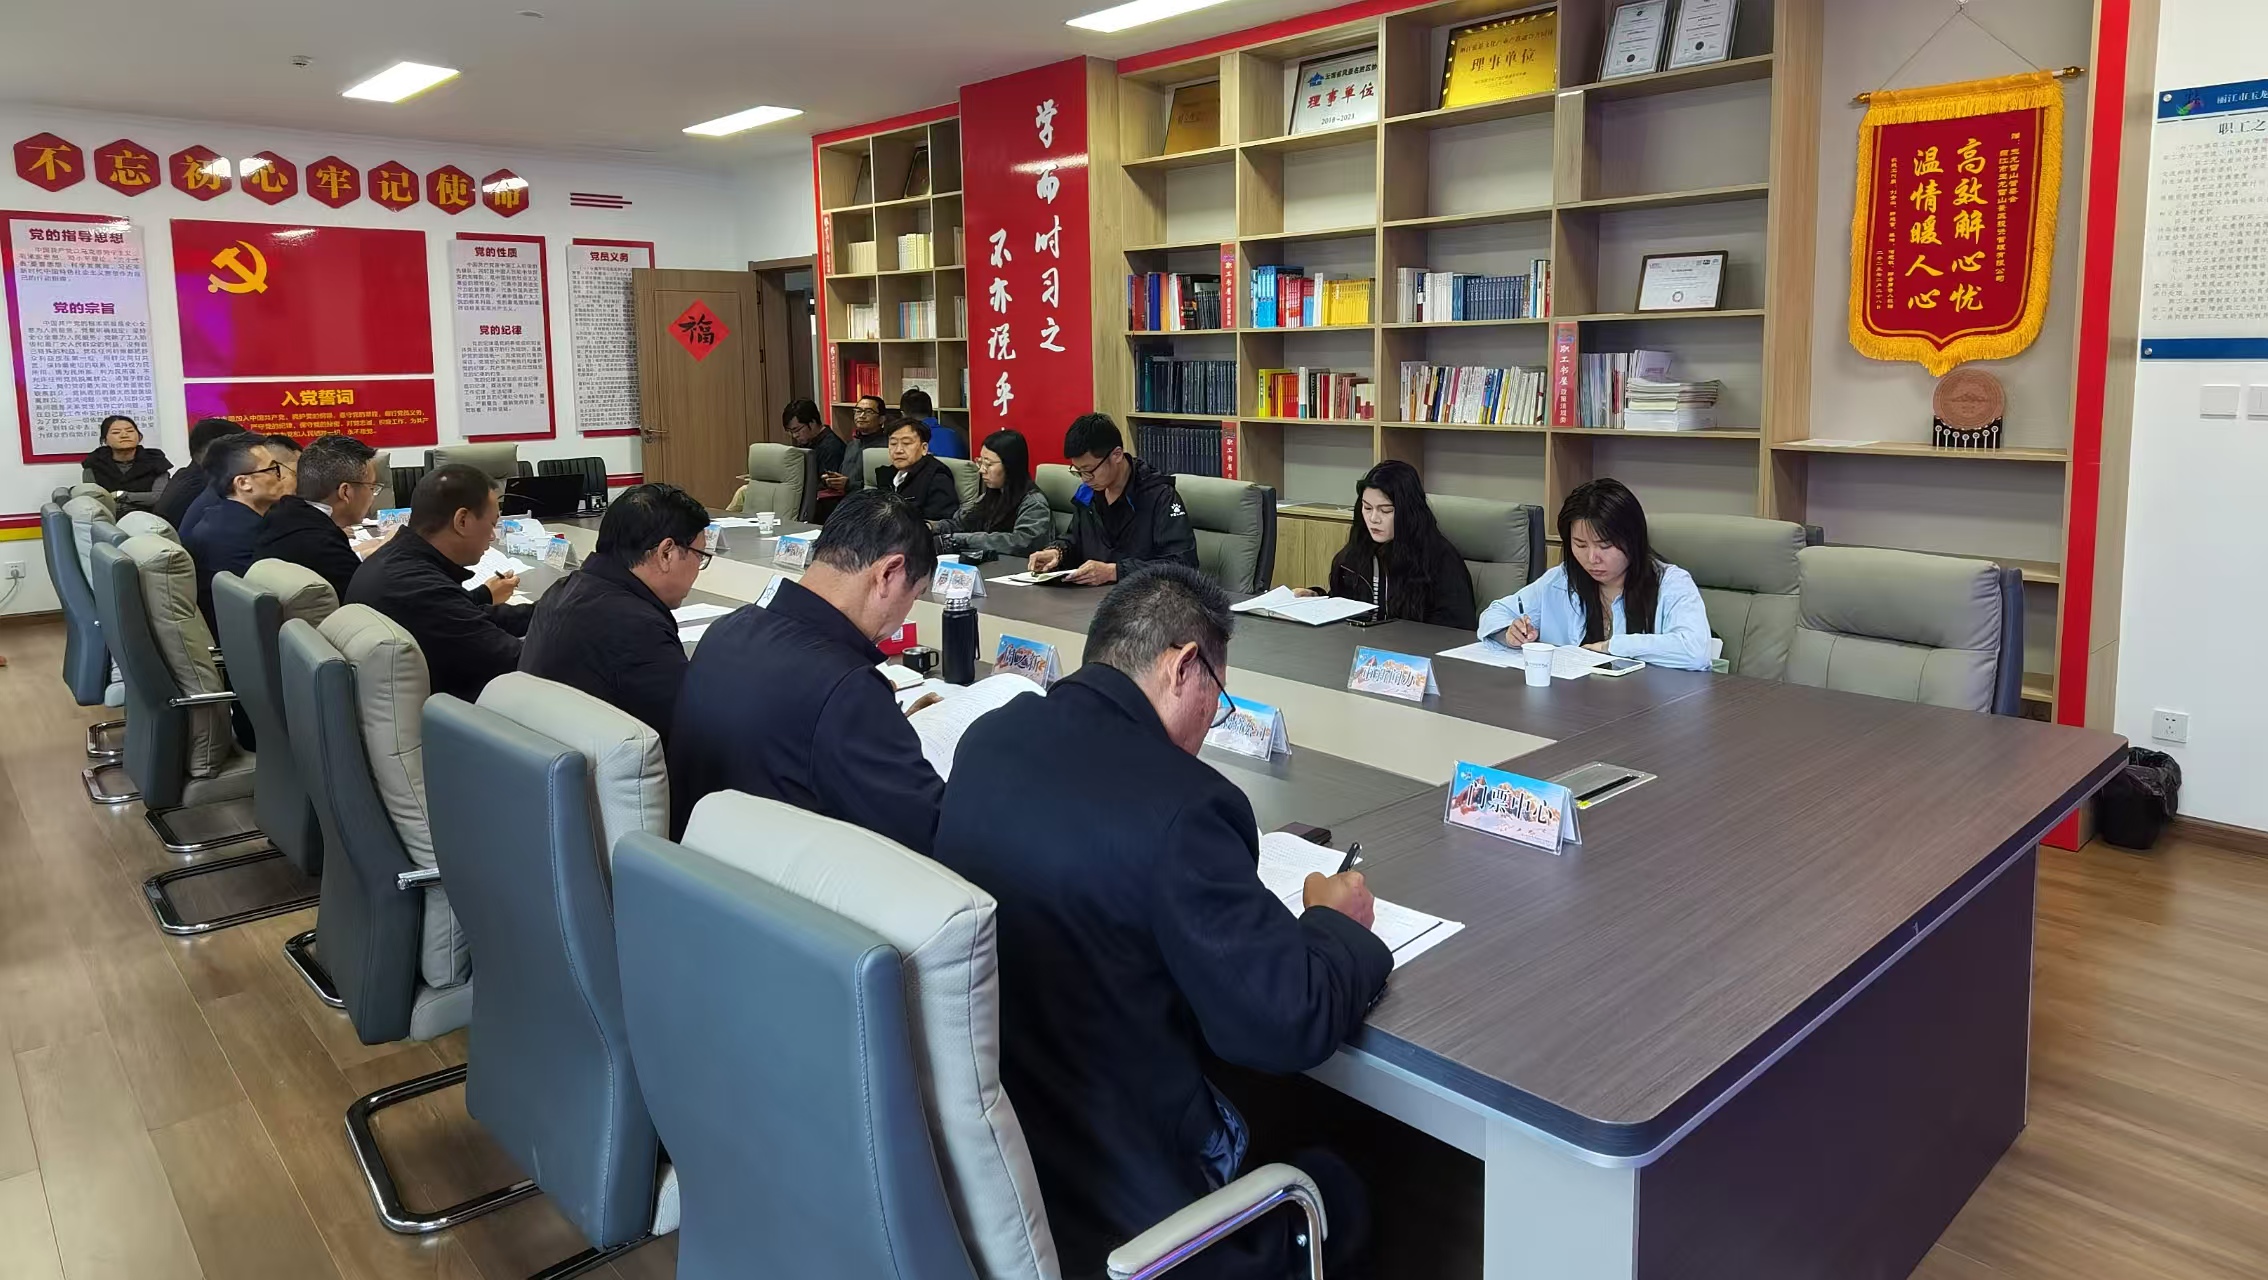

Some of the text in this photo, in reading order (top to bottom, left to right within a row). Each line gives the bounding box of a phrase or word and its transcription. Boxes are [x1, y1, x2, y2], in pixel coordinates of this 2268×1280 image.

[1306, 82, 1375, 109] 理事单位
[29, 228, 124, 244] 党的指导思想
[1034, 98, 1066, 352] 学而时习之
[1905, 146, 1944, 310] 温情暖人心
[1949, 138, 1988, 313] 高效解心忧
[474, 247, 518, 258] 党的性质
[590, 251, 629, 263] 党员义务
[53, 302, 116, 315] 党的宗旨
[988, 228, 1016, 416] 不亦说乎
[479, 325, 522, 336] 党的纪律
[679, 314, 715, 345] 福
[281, 389, 354, 407] 入党誓词
[1467, 782, 1553, 824] 门票中心
